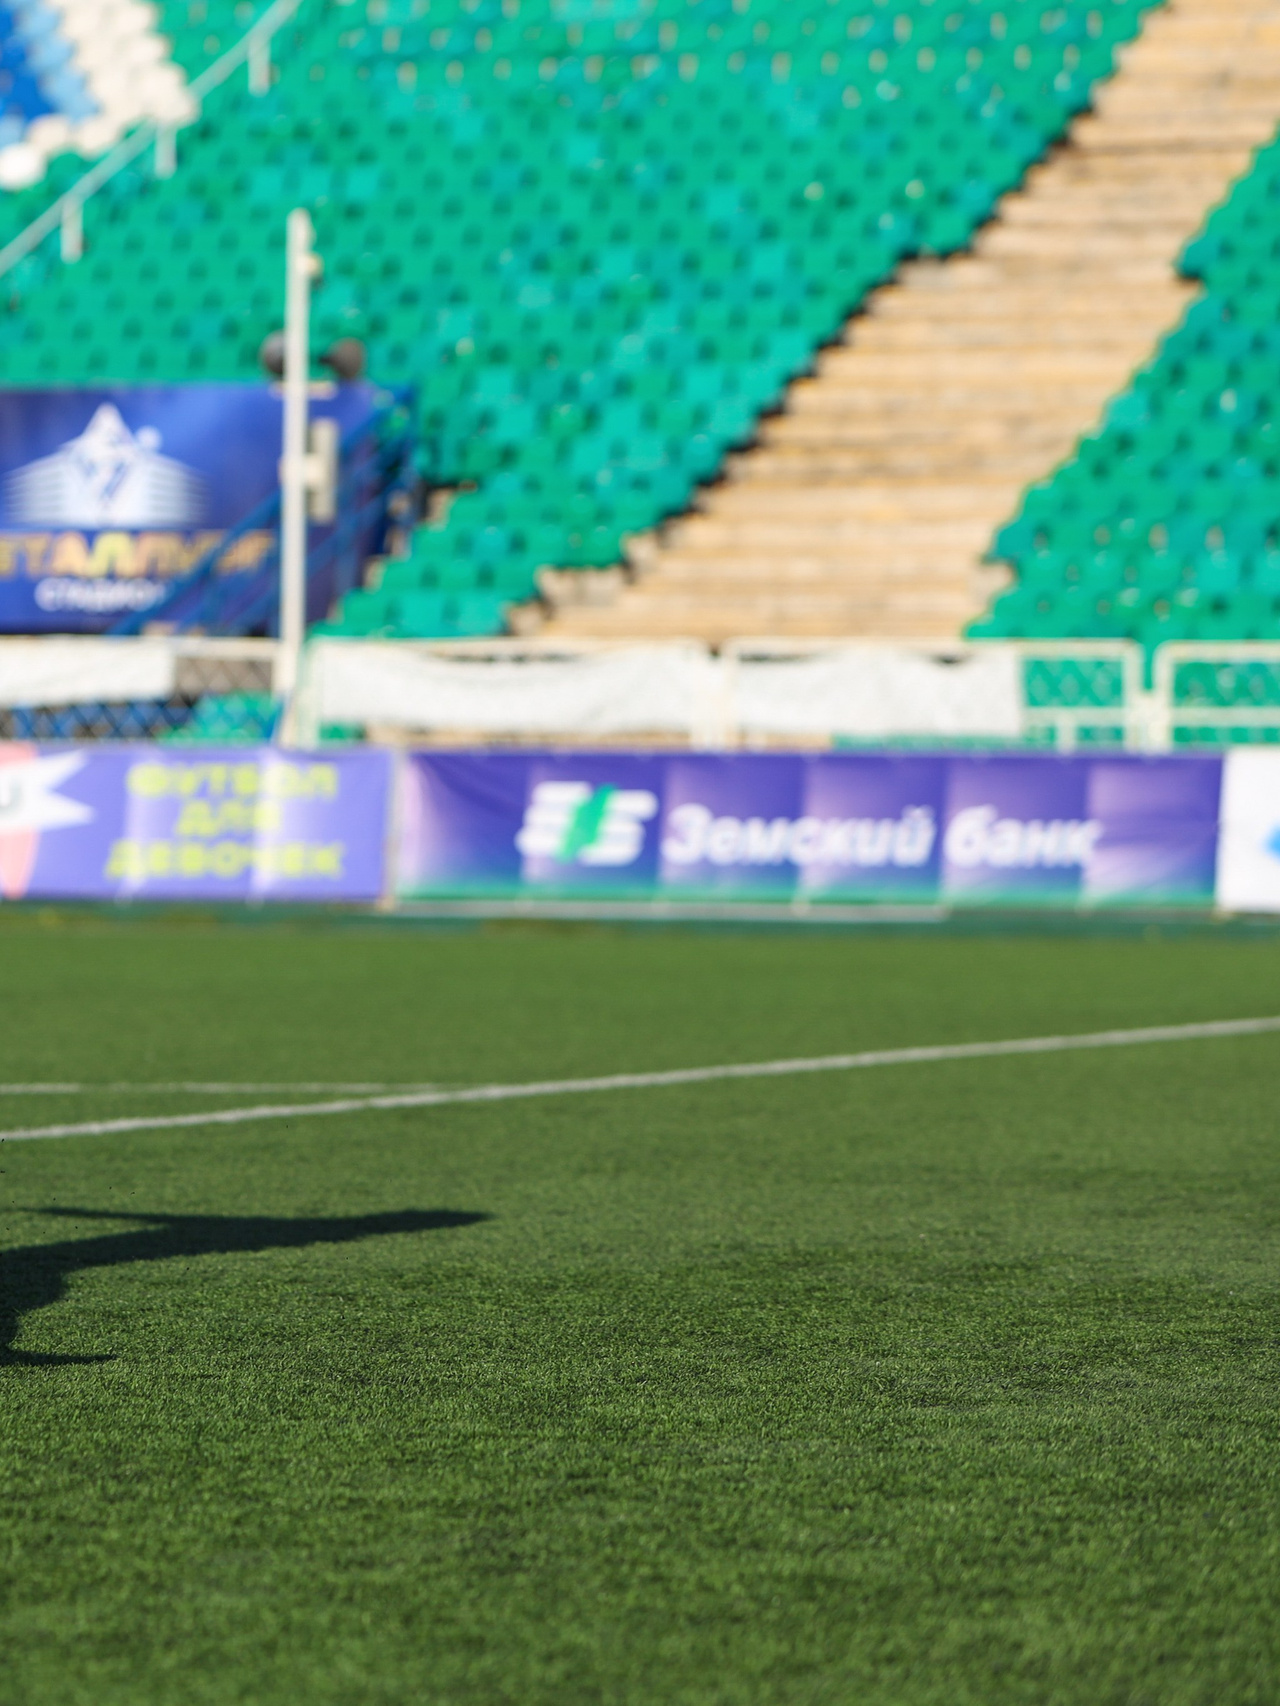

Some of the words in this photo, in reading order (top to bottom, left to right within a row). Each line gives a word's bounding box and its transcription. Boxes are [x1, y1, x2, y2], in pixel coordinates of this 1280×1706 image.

[128, 762, 337, 800] ФУТБОЛ
[177, 800, 281, 836] ДЛЯ
[663, 803, 936, 867] Земский
[943, 804, 1101, 867] банк
[105, 840, 345, 879] ДЕВОЧЕК
